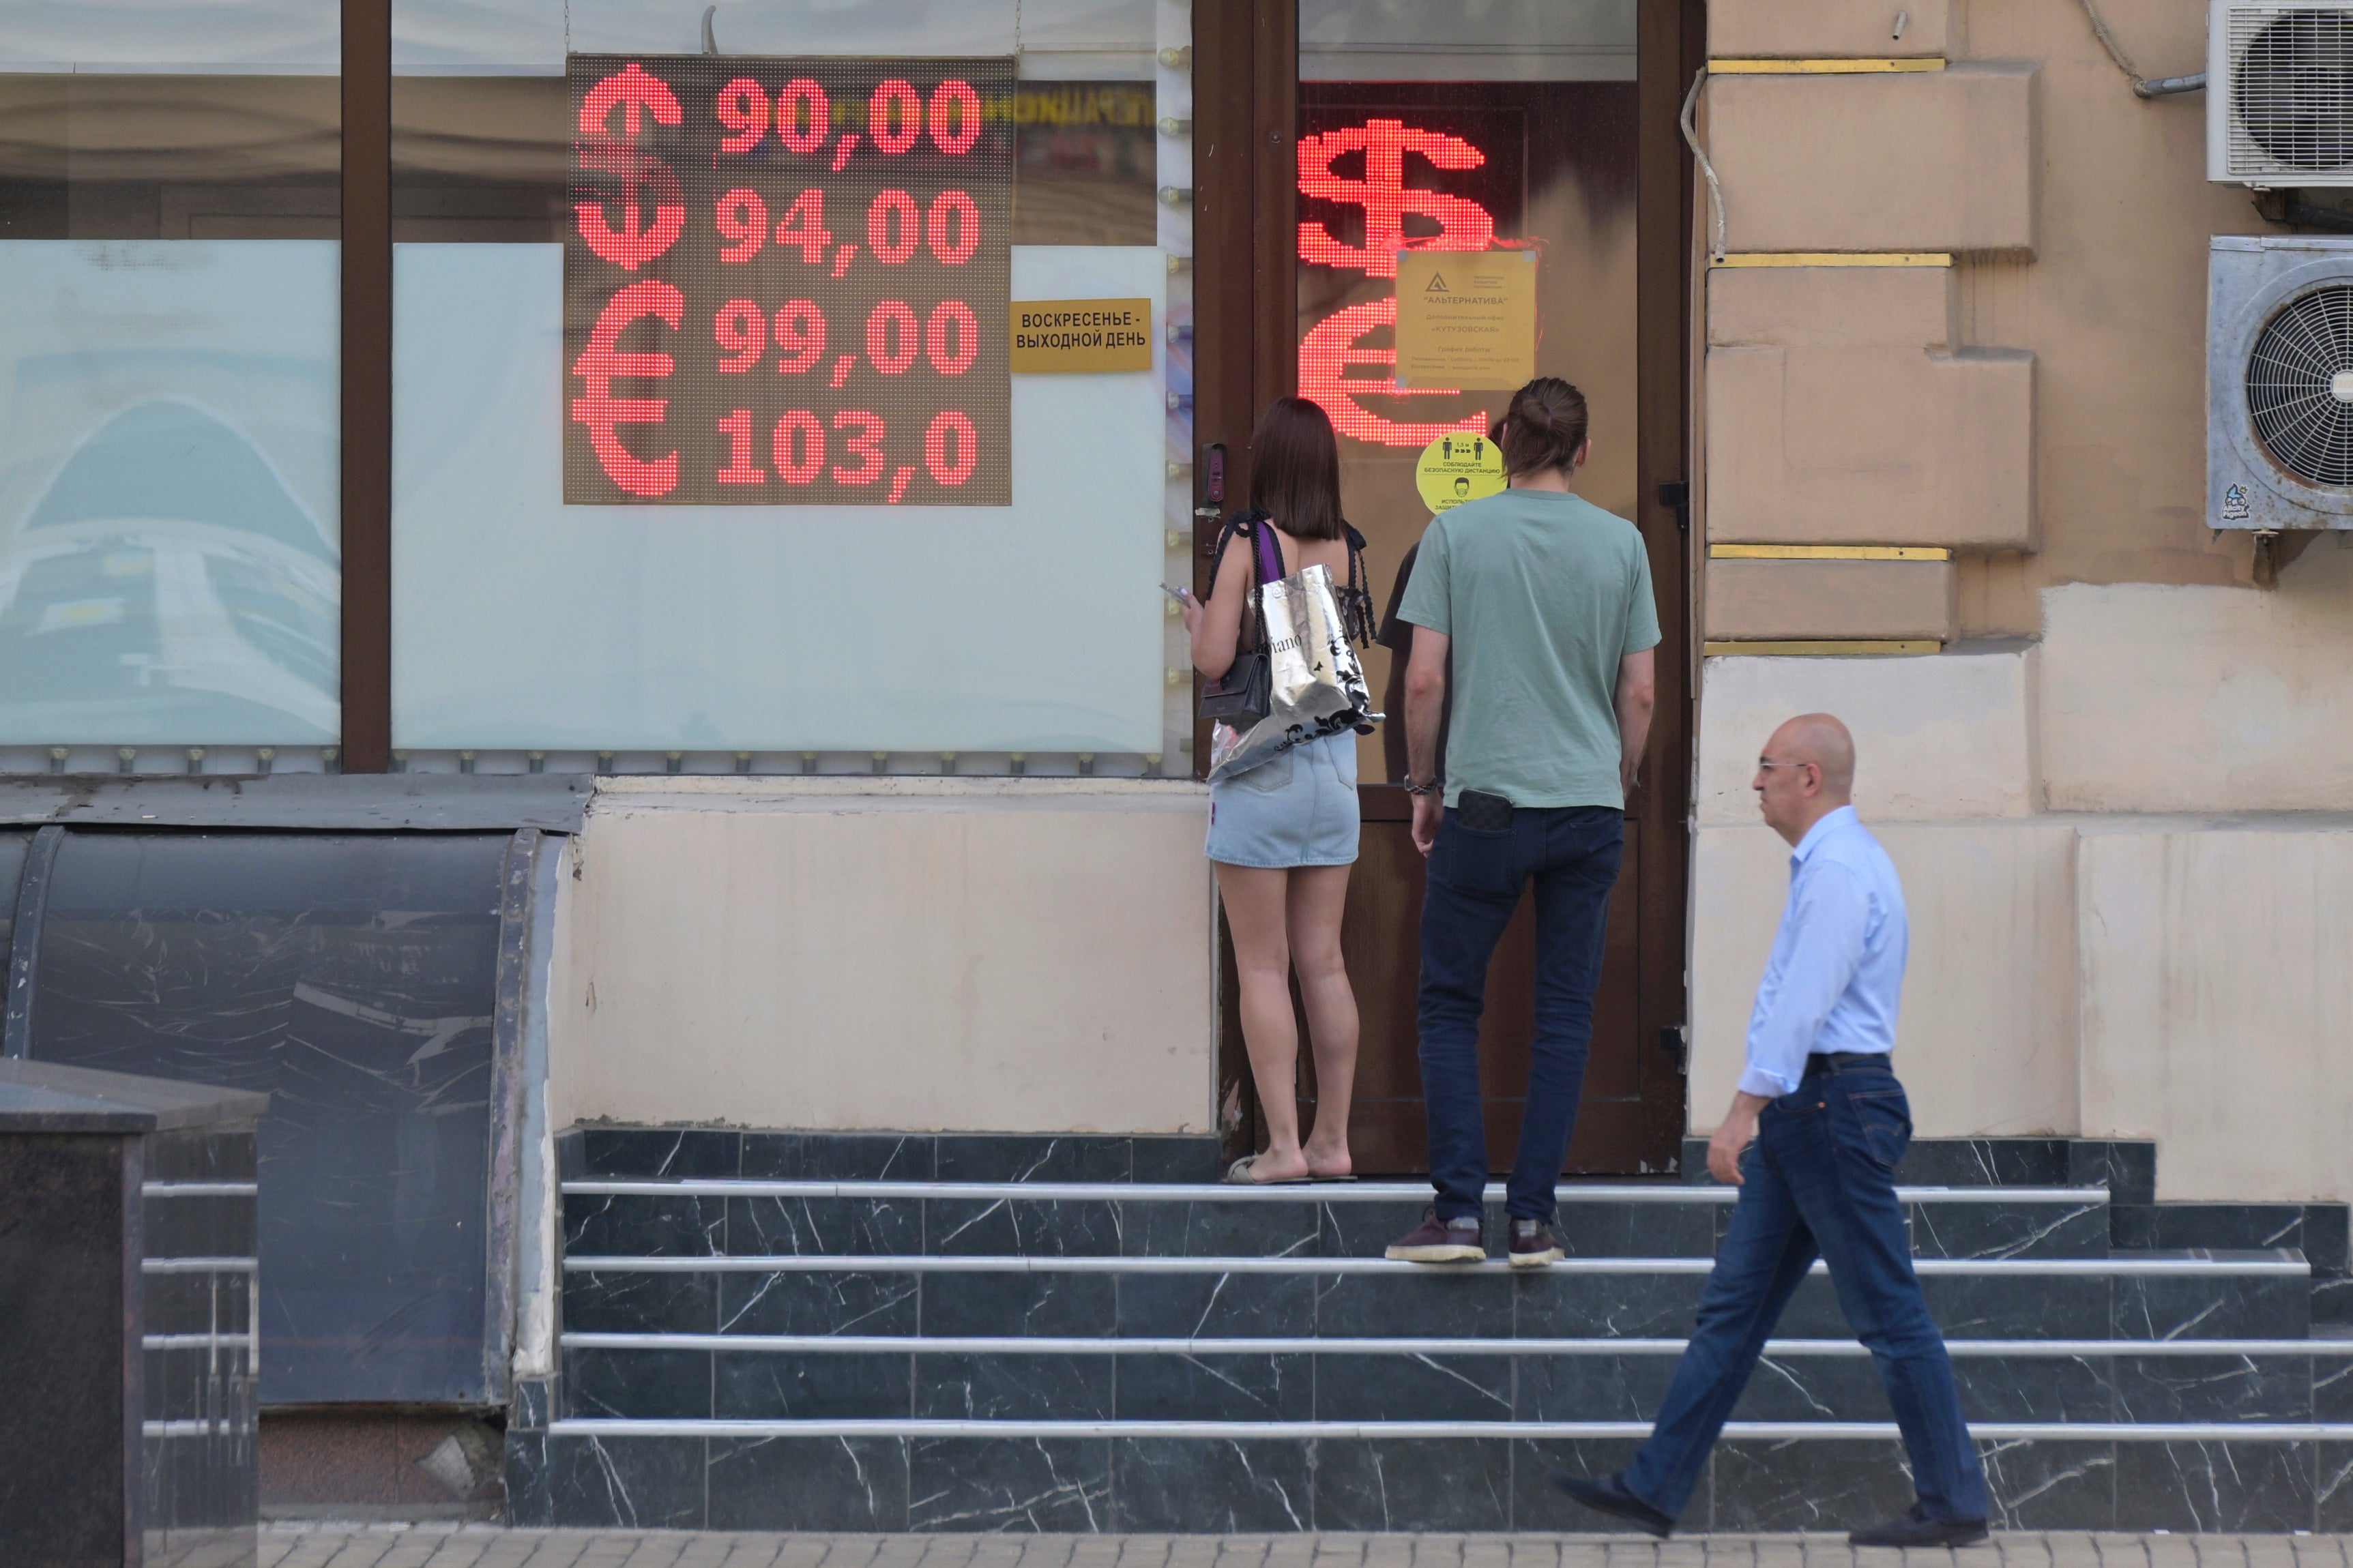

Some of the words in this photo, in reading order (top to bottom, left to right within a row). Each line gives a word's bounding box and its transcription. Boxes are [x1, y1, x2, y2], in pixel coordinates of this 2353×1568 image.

[716, 78, 981, 172] 90,00
[715, 188, 980, 278] 94,00
[714, 299, 978, 388] 99,00
[1017, 329, 1102, 350] ВЫХОДНОЙ
[1105, 331, 1146, 349] ДЕНЬ
[1022, 312, 1132, 328] ВОСКРЕСЕНЬЕ
[716, 410, 978, 504] 103,0
